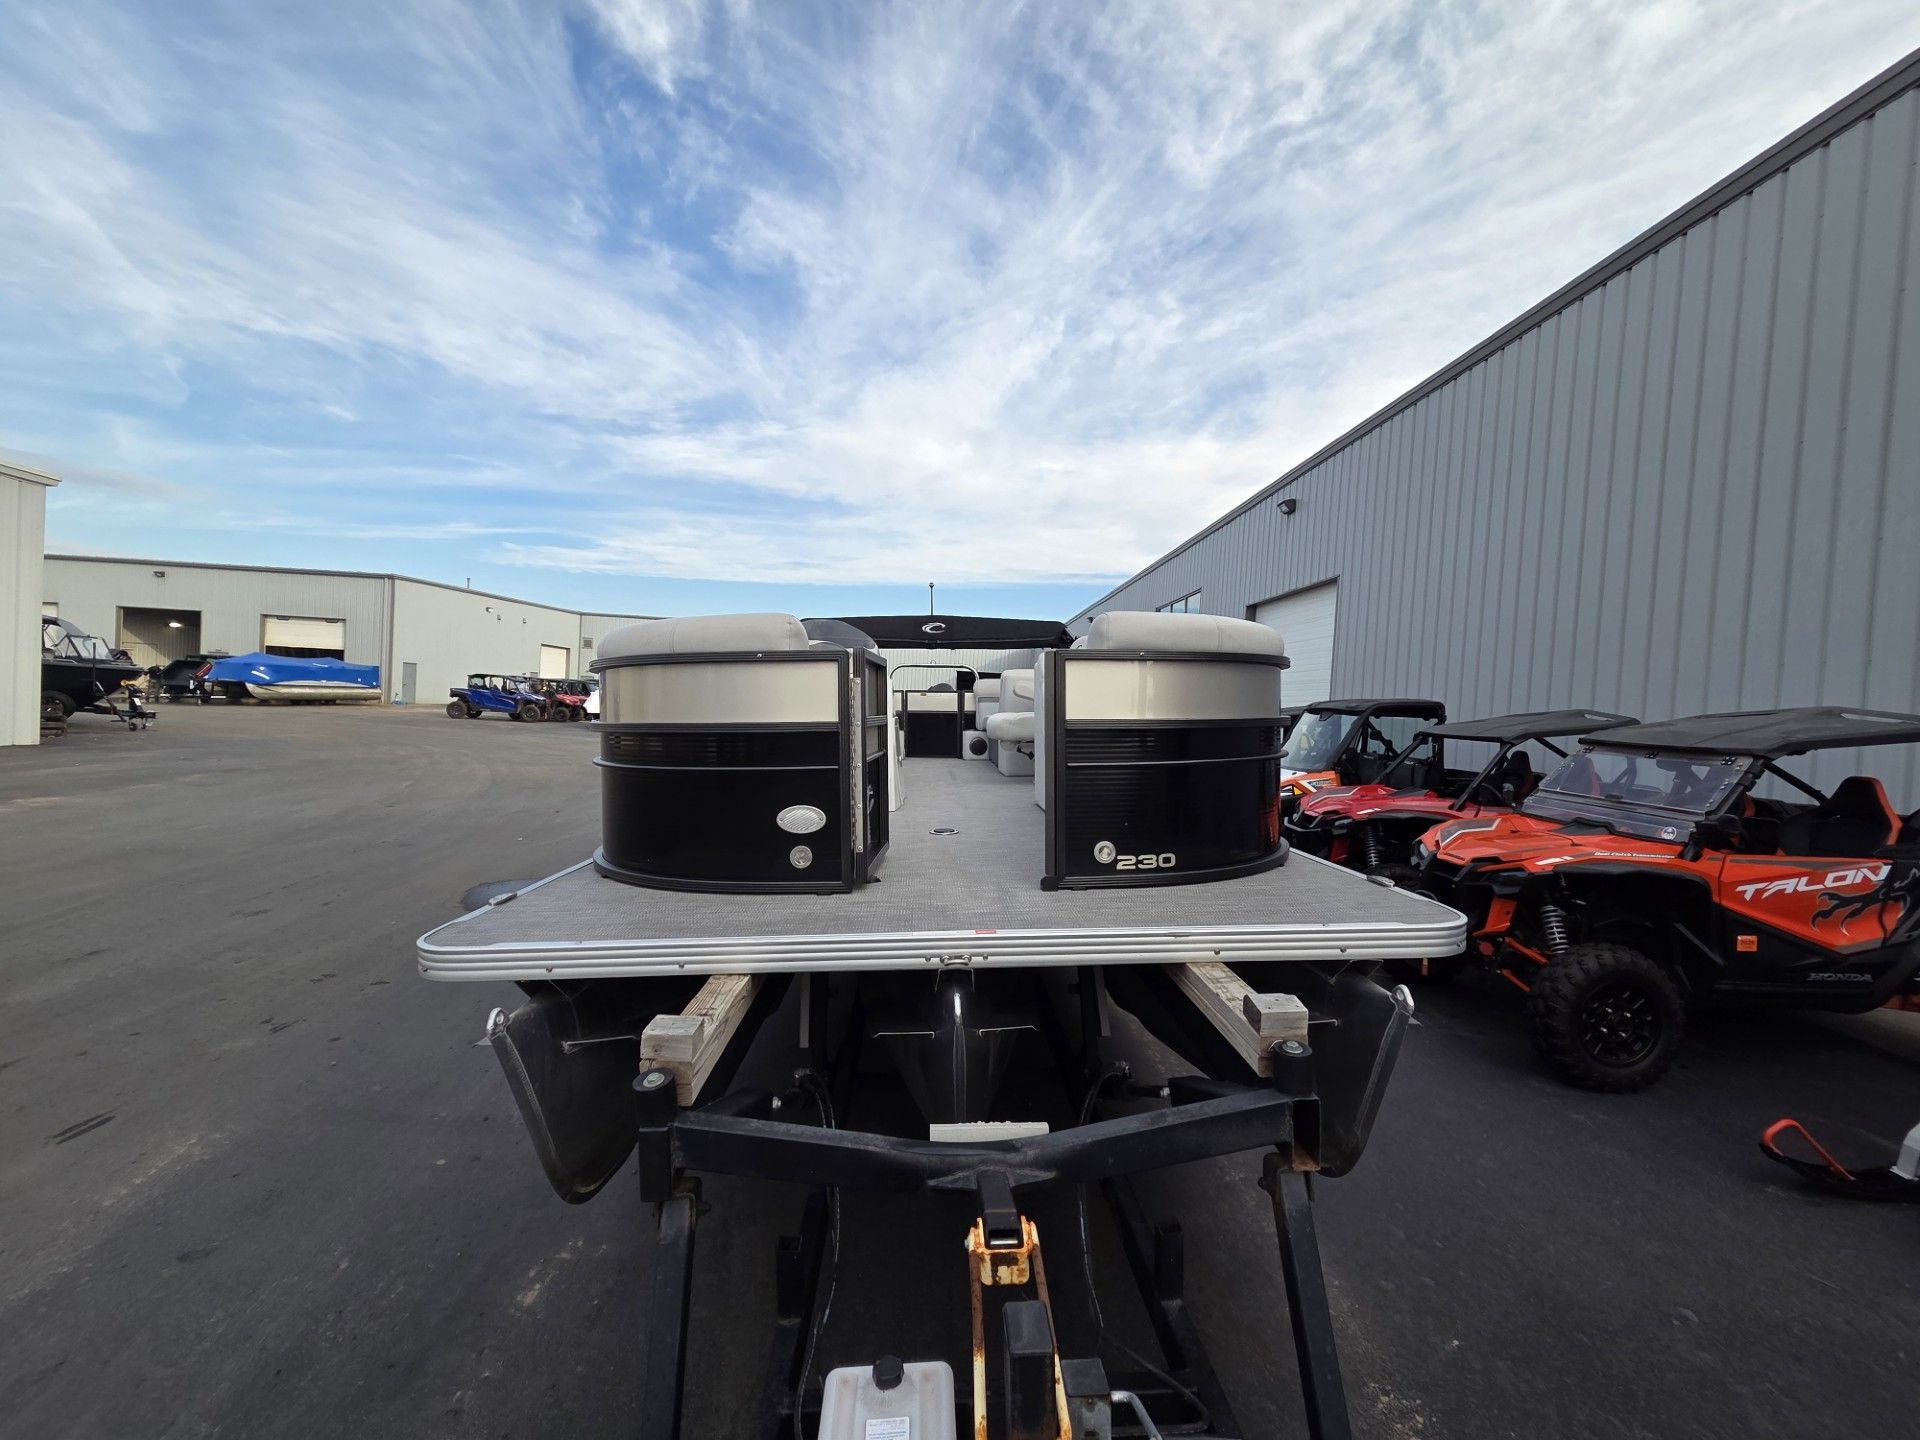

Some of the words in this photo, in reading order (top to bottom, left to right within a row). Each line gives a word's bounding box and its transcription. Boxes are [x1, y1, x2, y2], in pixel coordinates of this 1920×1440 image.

[1116, 853, 1176, 870] 230
[1735, 865, 1892, 901] TALON
[1807, 972, 1874, 982] HONDA
